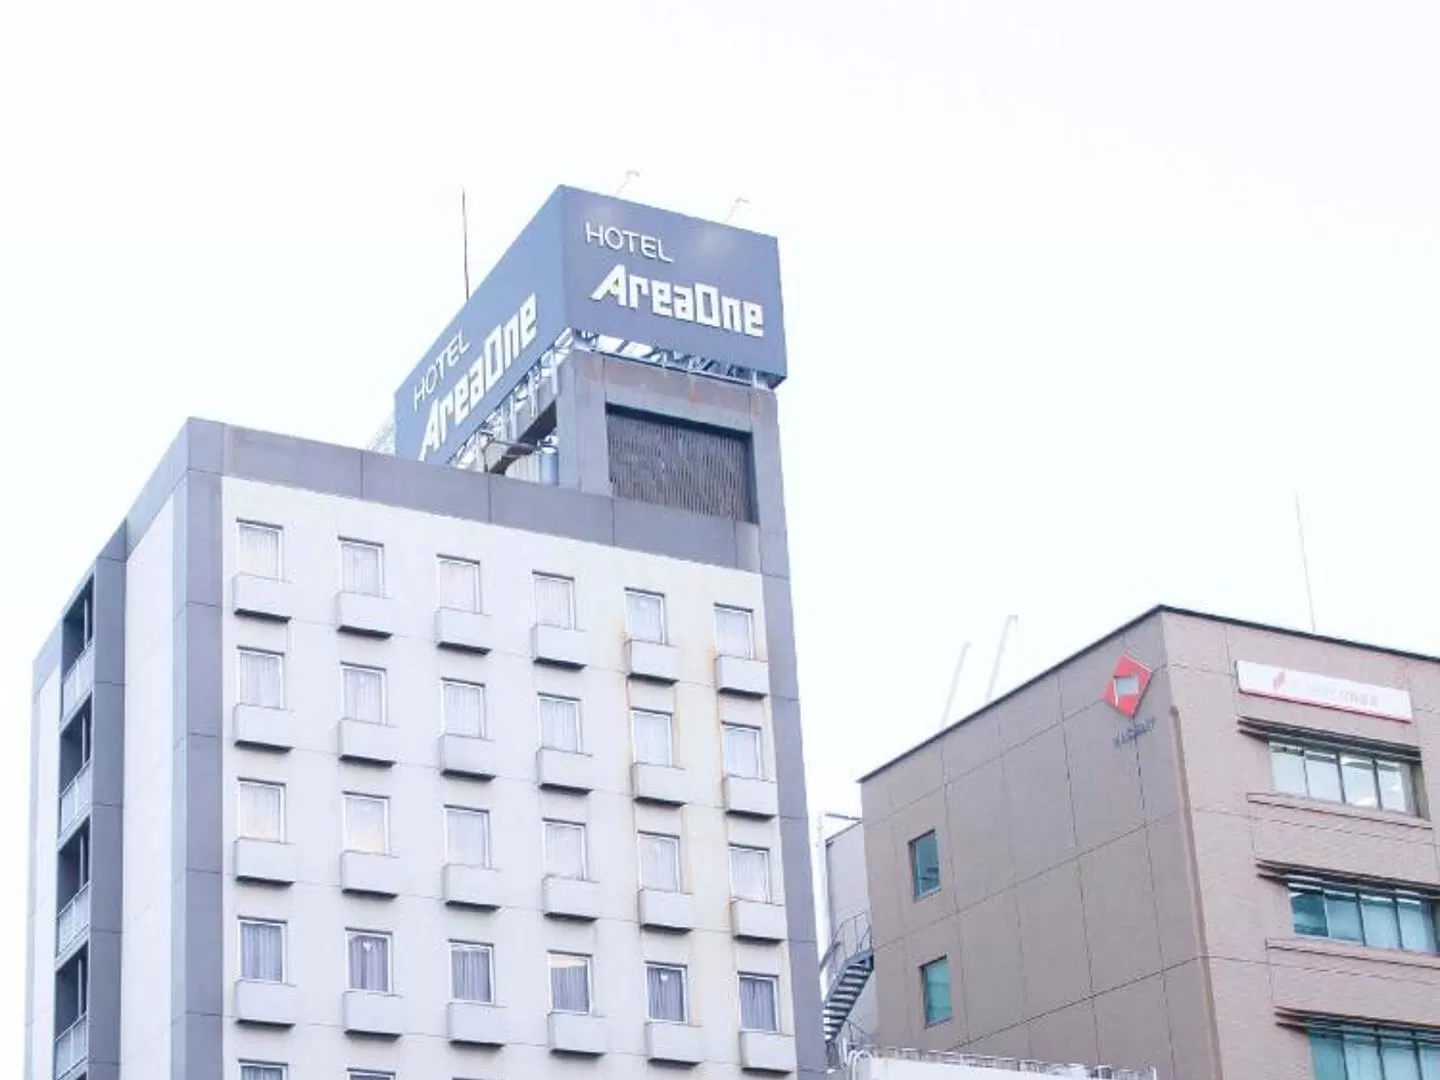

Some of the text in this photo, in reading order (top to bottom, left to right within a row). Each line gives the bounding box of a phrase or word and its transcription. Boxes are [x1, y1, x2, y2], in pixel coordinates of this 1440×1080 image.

[586, 221, 674, 263] HOTEL
[590, 264, 764, 337] AreaOne
[413, 329, 471, 413] HOTEL
[418, 292, 538, 462] AreaOne
